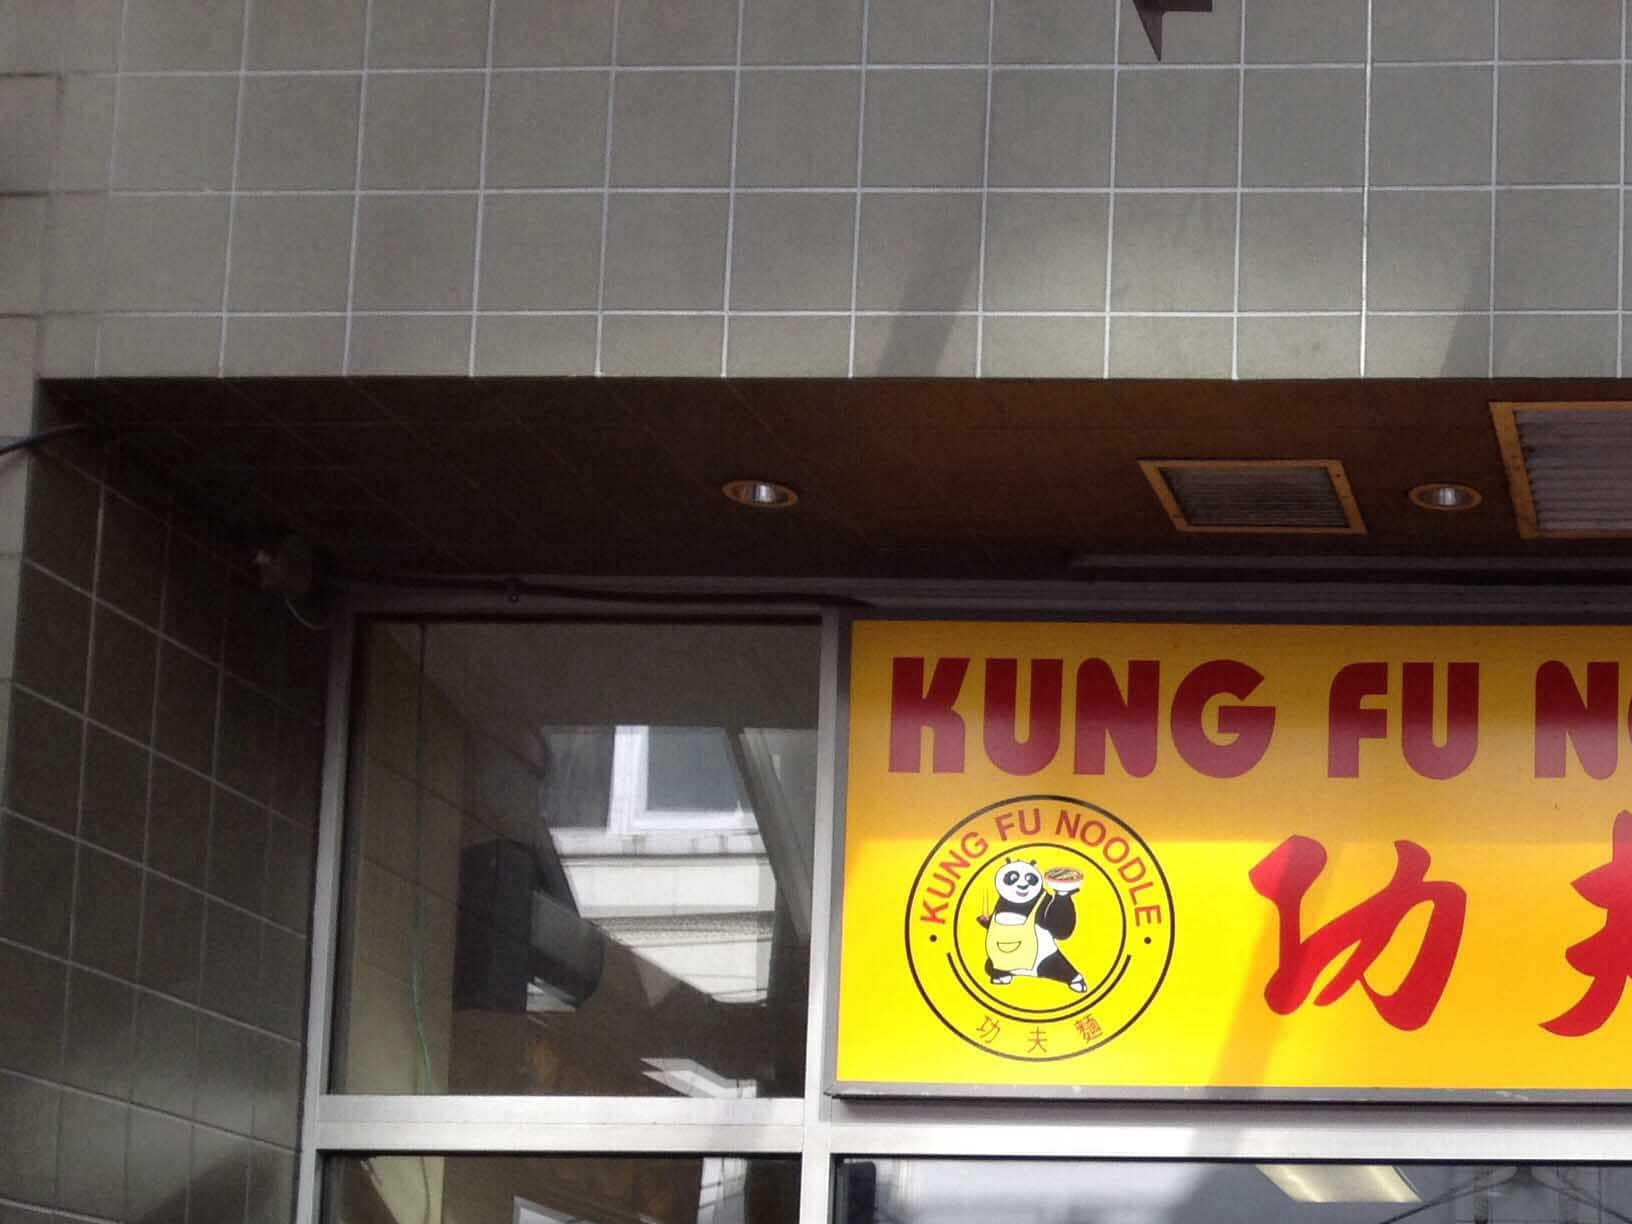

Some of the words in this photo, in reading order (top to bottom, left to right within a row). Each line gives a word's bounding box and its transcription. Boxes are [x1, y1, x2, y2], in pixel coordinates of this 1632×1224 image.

[888, 657, 1276, 776] KUNG
[1326, 660, 1480, 777] FU
[920, 831, 989, 925] KUNG
[995, 808, 1041, 841] FU
[1055, 809, 1162, 927] NOODLE
